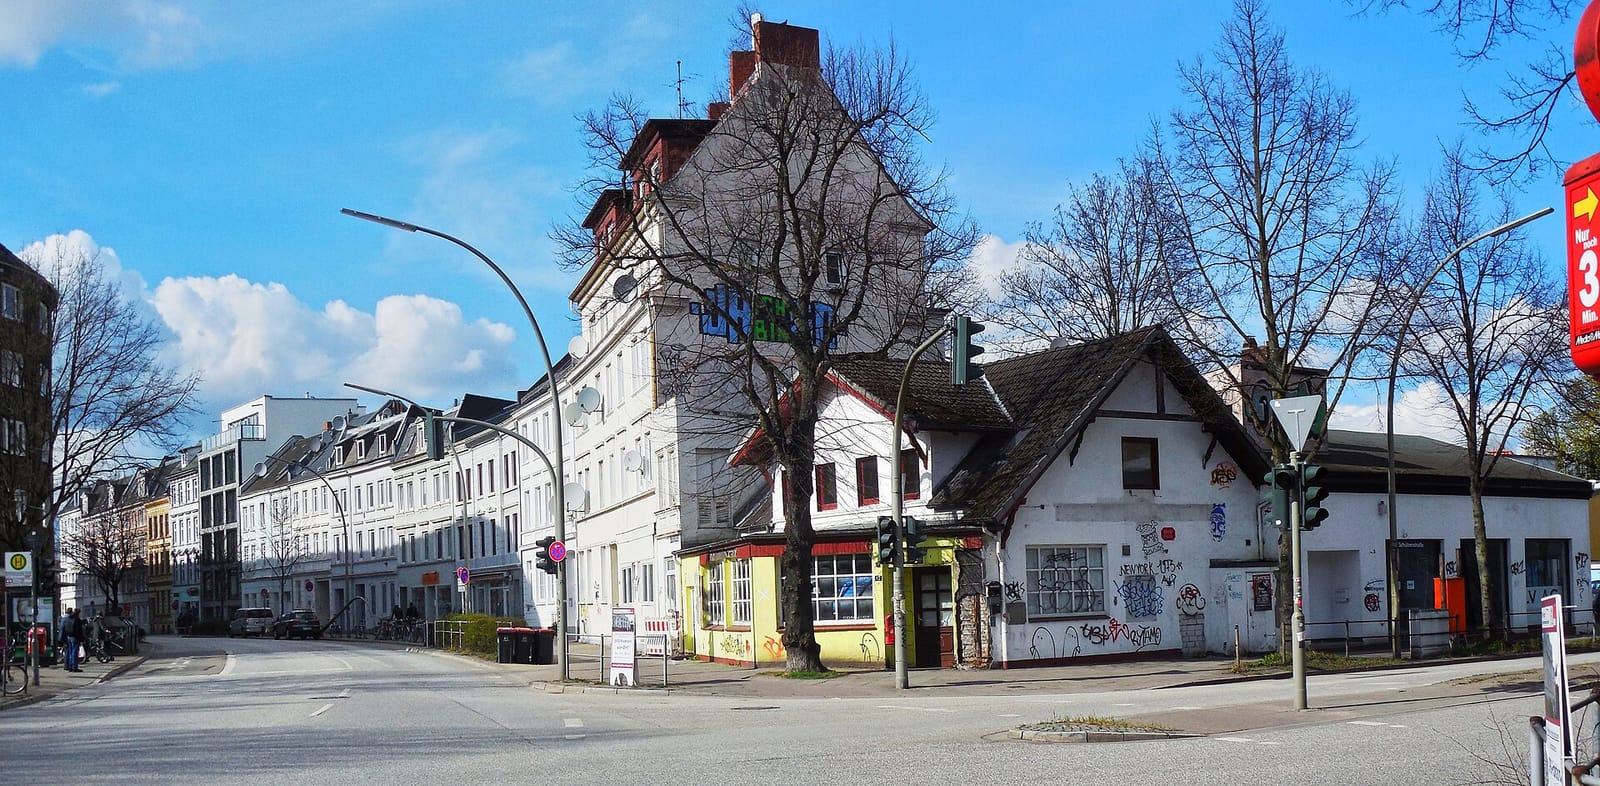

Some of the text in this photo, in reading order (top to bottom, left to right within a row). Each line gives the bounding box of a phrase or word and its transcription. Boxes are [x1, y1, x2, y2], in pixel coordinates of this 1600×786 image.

[1575, 228, 1590, 245] Nur
[1583, 236, 1598, 250] noch
[1579, 250, 1600, 308] 3
[1581, 309, 1599, 325] Min.
